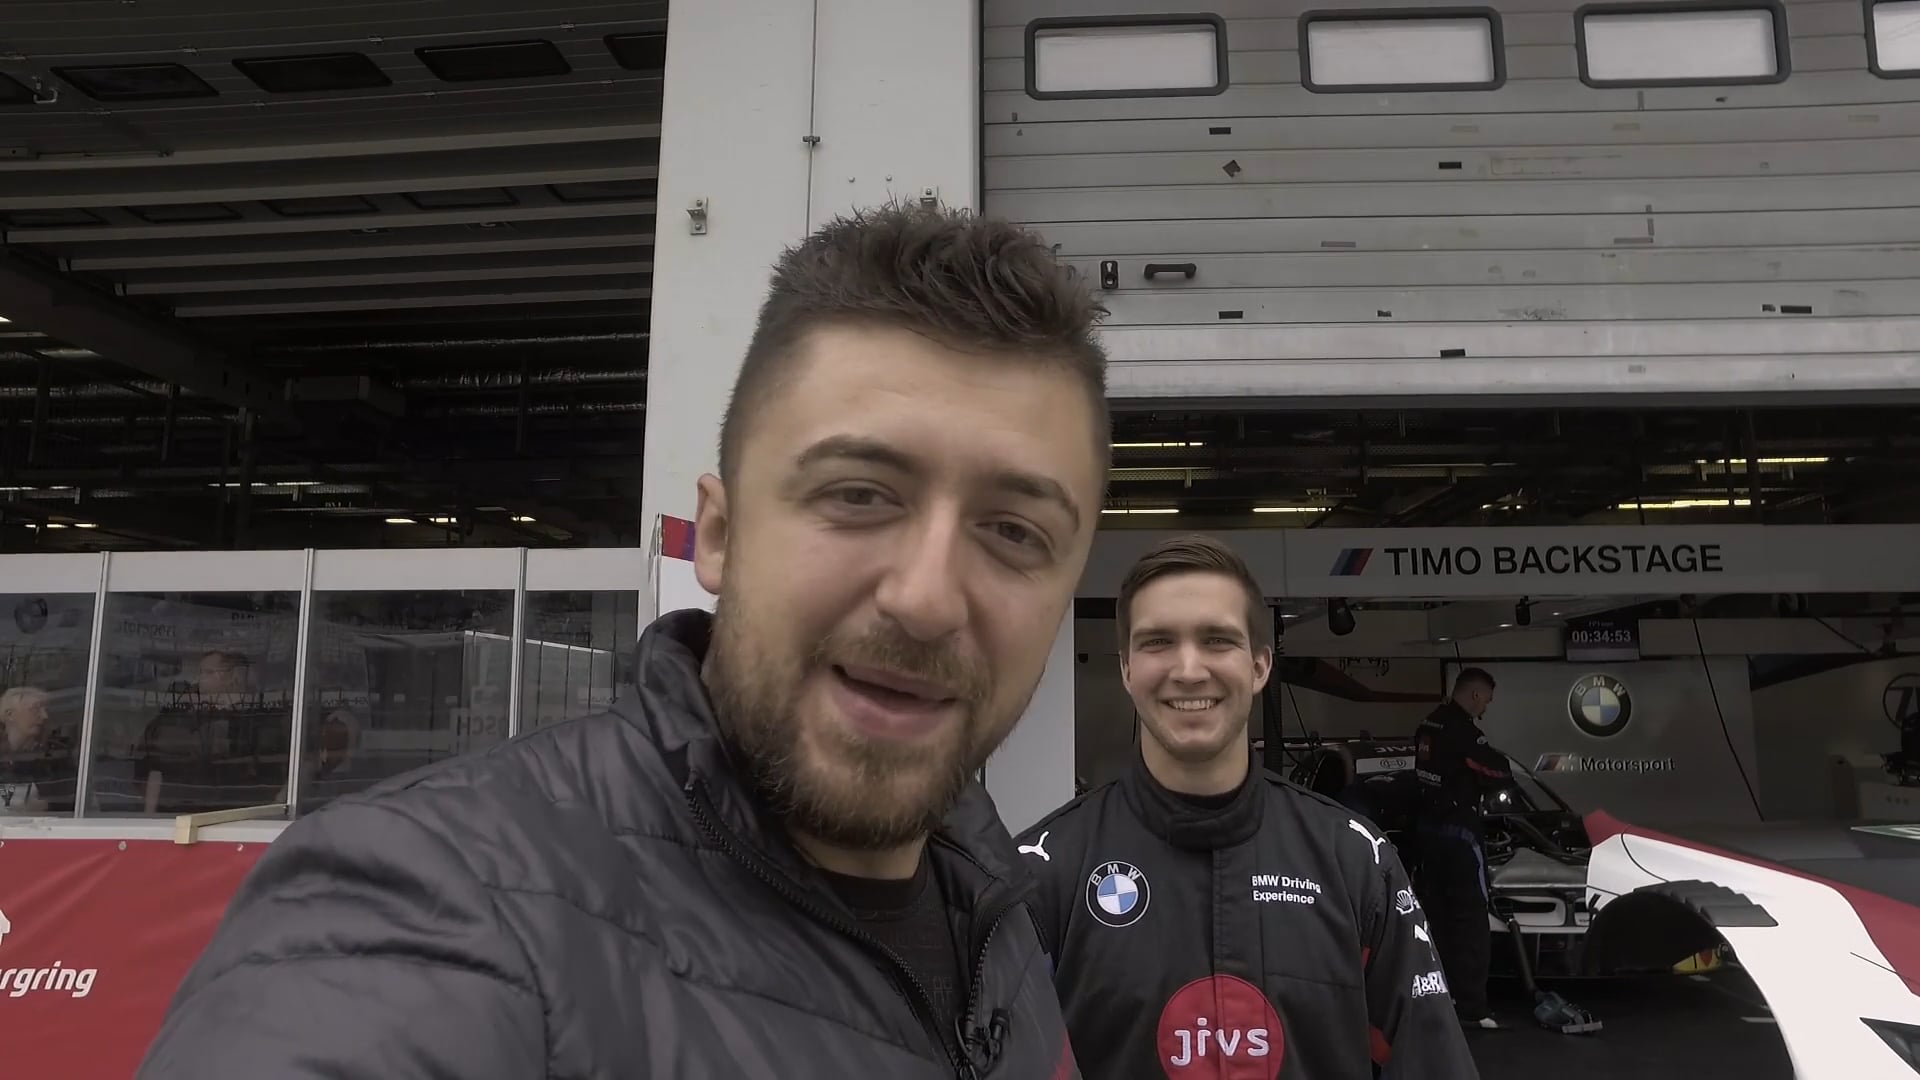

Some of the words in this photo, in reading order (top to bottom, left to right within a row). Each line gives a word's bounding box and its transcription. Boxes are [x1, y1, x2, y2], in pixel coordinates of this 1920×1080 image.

[1383, 546, 1482, 577] TIMO
[1493, 543, 1724, 575] BACKSTAGE
[1571, 629, 1632, 643] 00:34:53
[1574, 675, 1627, 697] BMW
[1580, 756, 1676, 774] Motorsport
[1088, 862, 1143, 887] BMW
[1251, 874, 1280, 888] BMW
[1280, 876, 1322, 893] Driving
[1252, 890, 1315, 905] Experience
[0, 960, 98, 998] rgring
[1170, 1016, 1271, 1067] jivs
